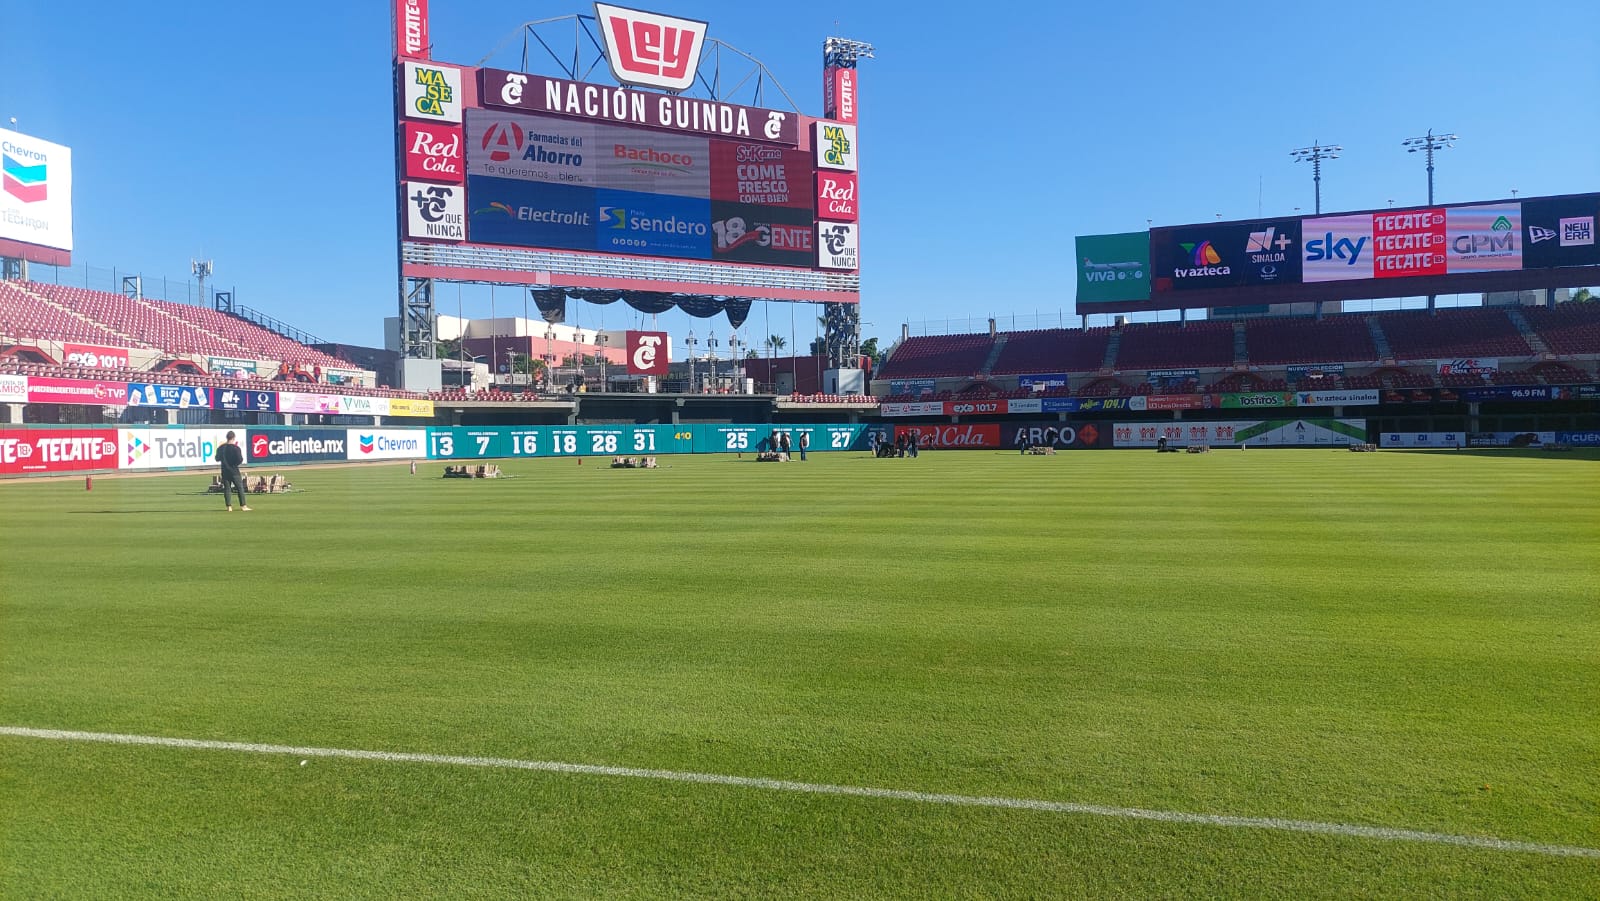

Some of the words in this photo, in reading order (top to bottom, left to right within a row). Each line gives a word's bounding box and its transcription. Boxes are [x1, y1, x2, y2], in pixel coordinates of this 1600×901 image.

[405, 3, 420, 54] TECATE
[546, 80, 646, 124] NACIÓN
[658, 96, 750, 136] GUINDA
[841, 78, 853, 120] TECATE
[410, 131, 461, 158] Red
[528, 131, 568, 146] Farmacias
[570, 136, 582, 147] del
[2, 141, 47, 161] Chevron
[522, 144, 583, 166] Ahorro
[614, 144, 692, 166] Bachoco
[423, 156, 456, 173] Cola
[484, 164, 495, 173] Te
[737, 164, 785, 181] COME
[740, 194, 765, 203] COME
[767, 194, 789, 203] BIEN
[820, 179, 855, 201] Red
[829, 200, 853, 214] Cola
[445, 213, 462, 225] QUE
[518, 206, 590, 227] Electrolit
[1375, 213, 1432, 231] TECATE
[427, 223, 463, 239] NUNCA
[630, 215, 707, 237] sendero
[1564, 222, 1590, 232] NEW
[754, 226, 812, 249] GENTE
[1376, 233, 1433, 251] TECATE
[1452, 232, 1513, 254] GPM
[1564, 232, 1590, 242] ERA
[844, 247, 857, 258] QUE
[1305, 232, 1368, 265] sky
[831, 256, 857, 268] NUNCA
[1252, 253, 1285, 264] SINALOA
[1376, 253, 1433, 271] TECATE
[1174, 268, 1188, 278] tv
[1189, 266, 1231, 277] azteca
[99, 355, 127, 370] 1017
[108, 388, 126, 399] TVP
[161, 390, 180, 399] RICA
[1324, 394, 1347, 402] azteca
[1349, 393, 1377, 401] sinaloa
[1511, 390, 1530, 399] 96.9
[1531, 390, 1546, 398] FM
[976, 402, 998, 413] 101.7
[377, 436, 418, 452] Chevron
[513, 435, 537, 454] 16
[553, 435, 577, 453] 18
[592, 434, 617, 453] 28
[633, 432, 656, 451] 31
[674, 432, 692, 441] 410
[726, 432, 748, 449] 25
[831, 431, 850, 448] 27
[941, 425, 984, 446] Cola
[36, 437, 106, 462] TECATE
[154, 436, 239, 463] Totalpl
[269, 436, 344, 455] caliente.mx
[431, 436, 453, 456] 13
[476, 436, 490, 455] 7
